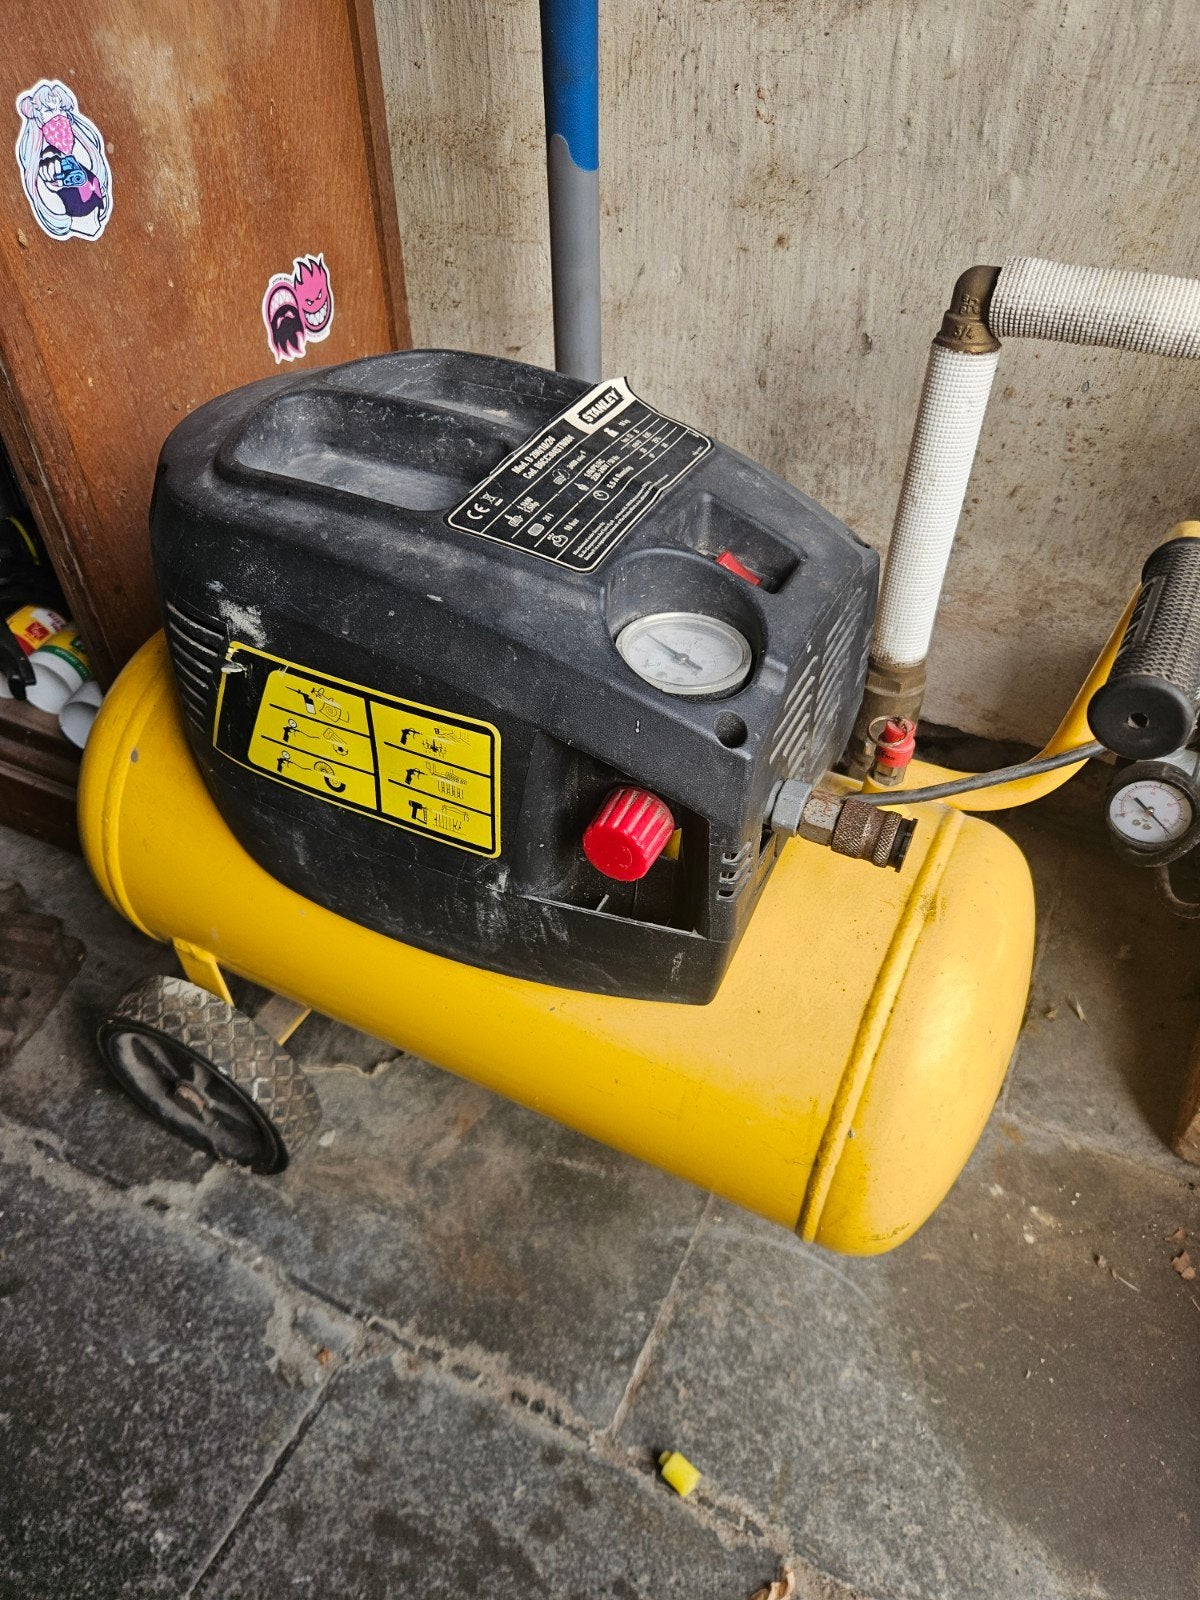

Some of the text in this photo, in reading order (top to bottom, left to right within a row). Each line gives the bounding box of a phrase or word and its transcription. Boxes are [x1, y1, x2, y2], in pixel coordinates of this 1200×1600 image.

[582, 390, 620, 423] STANLEY
[511, 461, 530, 474] Mod.
[522, 467, 539, 479] Cod.
[467, 503, 490, 520] CE
[568, 518, 579, 527] bar
